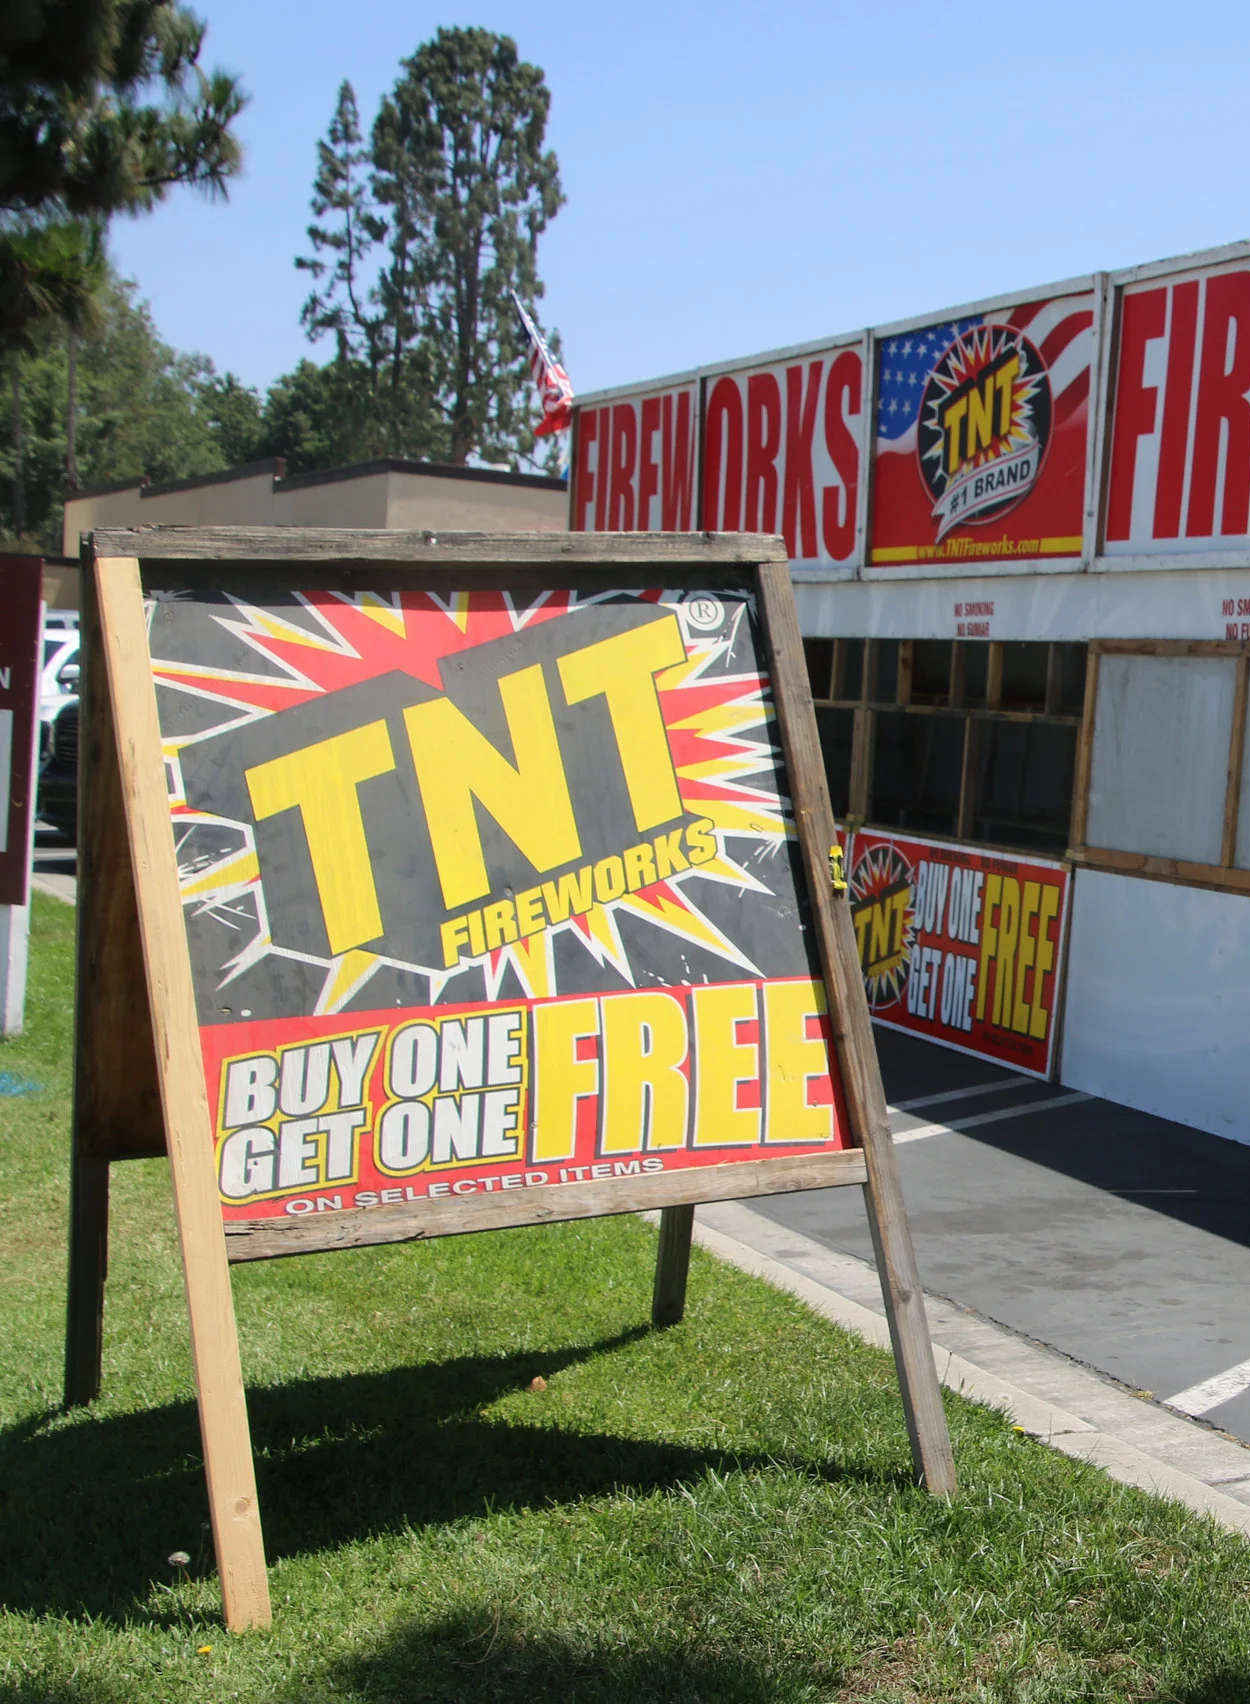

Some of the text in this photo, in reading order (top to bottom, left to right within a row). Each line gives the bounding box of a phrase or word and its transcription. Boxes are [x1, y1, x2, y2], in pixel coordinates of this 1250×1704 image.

[576, 350, 863, 562] FIREWORKS
[943, 353, 1020, 475] TNT
[949, 459, 1031, 514] #1 BRAND
[1222, 599, 1234, 616] NO
[1226, 623, 1238, 641] NO
[245, 616, 687, 956] TNT
[439, 815, 720, 969] FIREWORKS
[854, 886, 912, 974] TNT
[913, 859, 984, 945] BUY ONE
[907, 943, 977, 1033] GET ONE
[976, 873, 1060, 1041] FREE
[222, 1011, 523, 1130] BUY ONE
[527, 980, 834, 1165] FREE
[219, 1087, 518, 1199] GET ONE
[284, 1157, 665, 1215] ON SELECTED ITEMS
